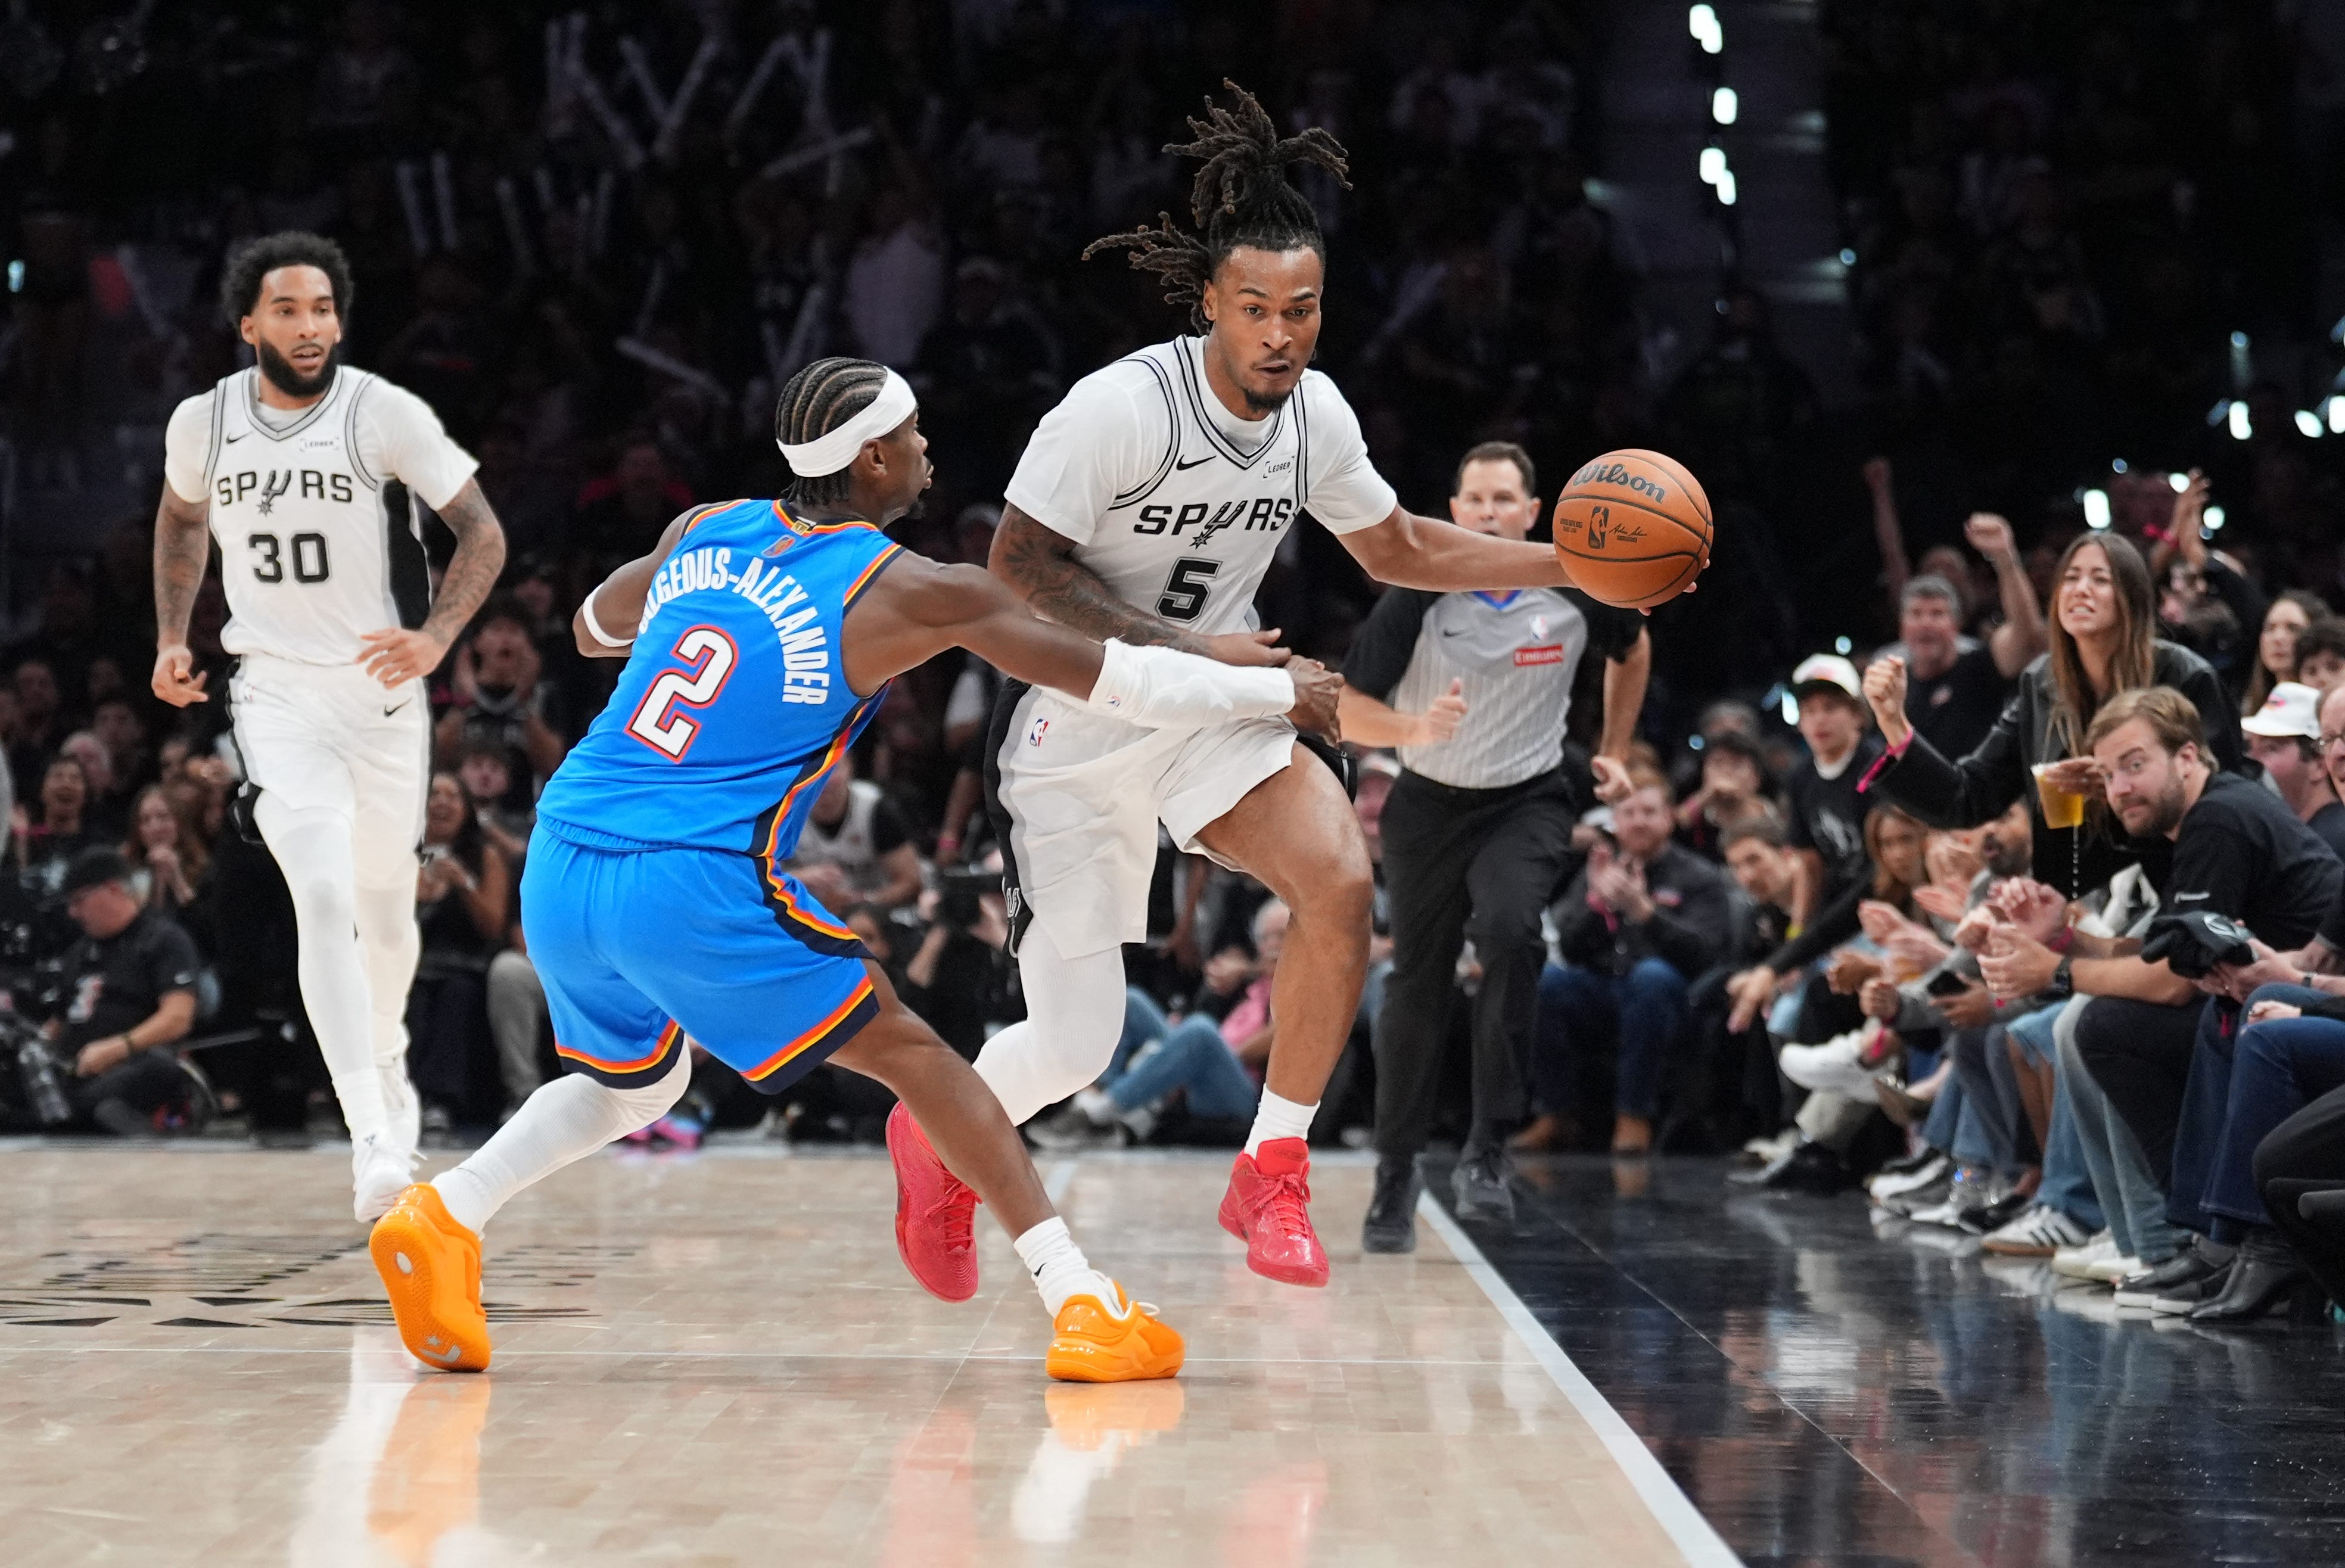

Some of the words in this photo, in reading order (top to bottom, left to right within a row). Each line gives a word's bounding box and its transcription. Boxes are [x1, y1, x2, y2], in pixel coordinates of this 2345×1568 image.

[1268, 461, 1291, 473] LEDGER
[1572, 463, 1666, 505] Wilson
[217, 469, 353, 517] SPURS
[1133, 498, 1293, 549] SPURS
[247, 533, 331, 585] 30
[1154, 556, 1223, 623] 5
[624, 623, 739, 764] 2
